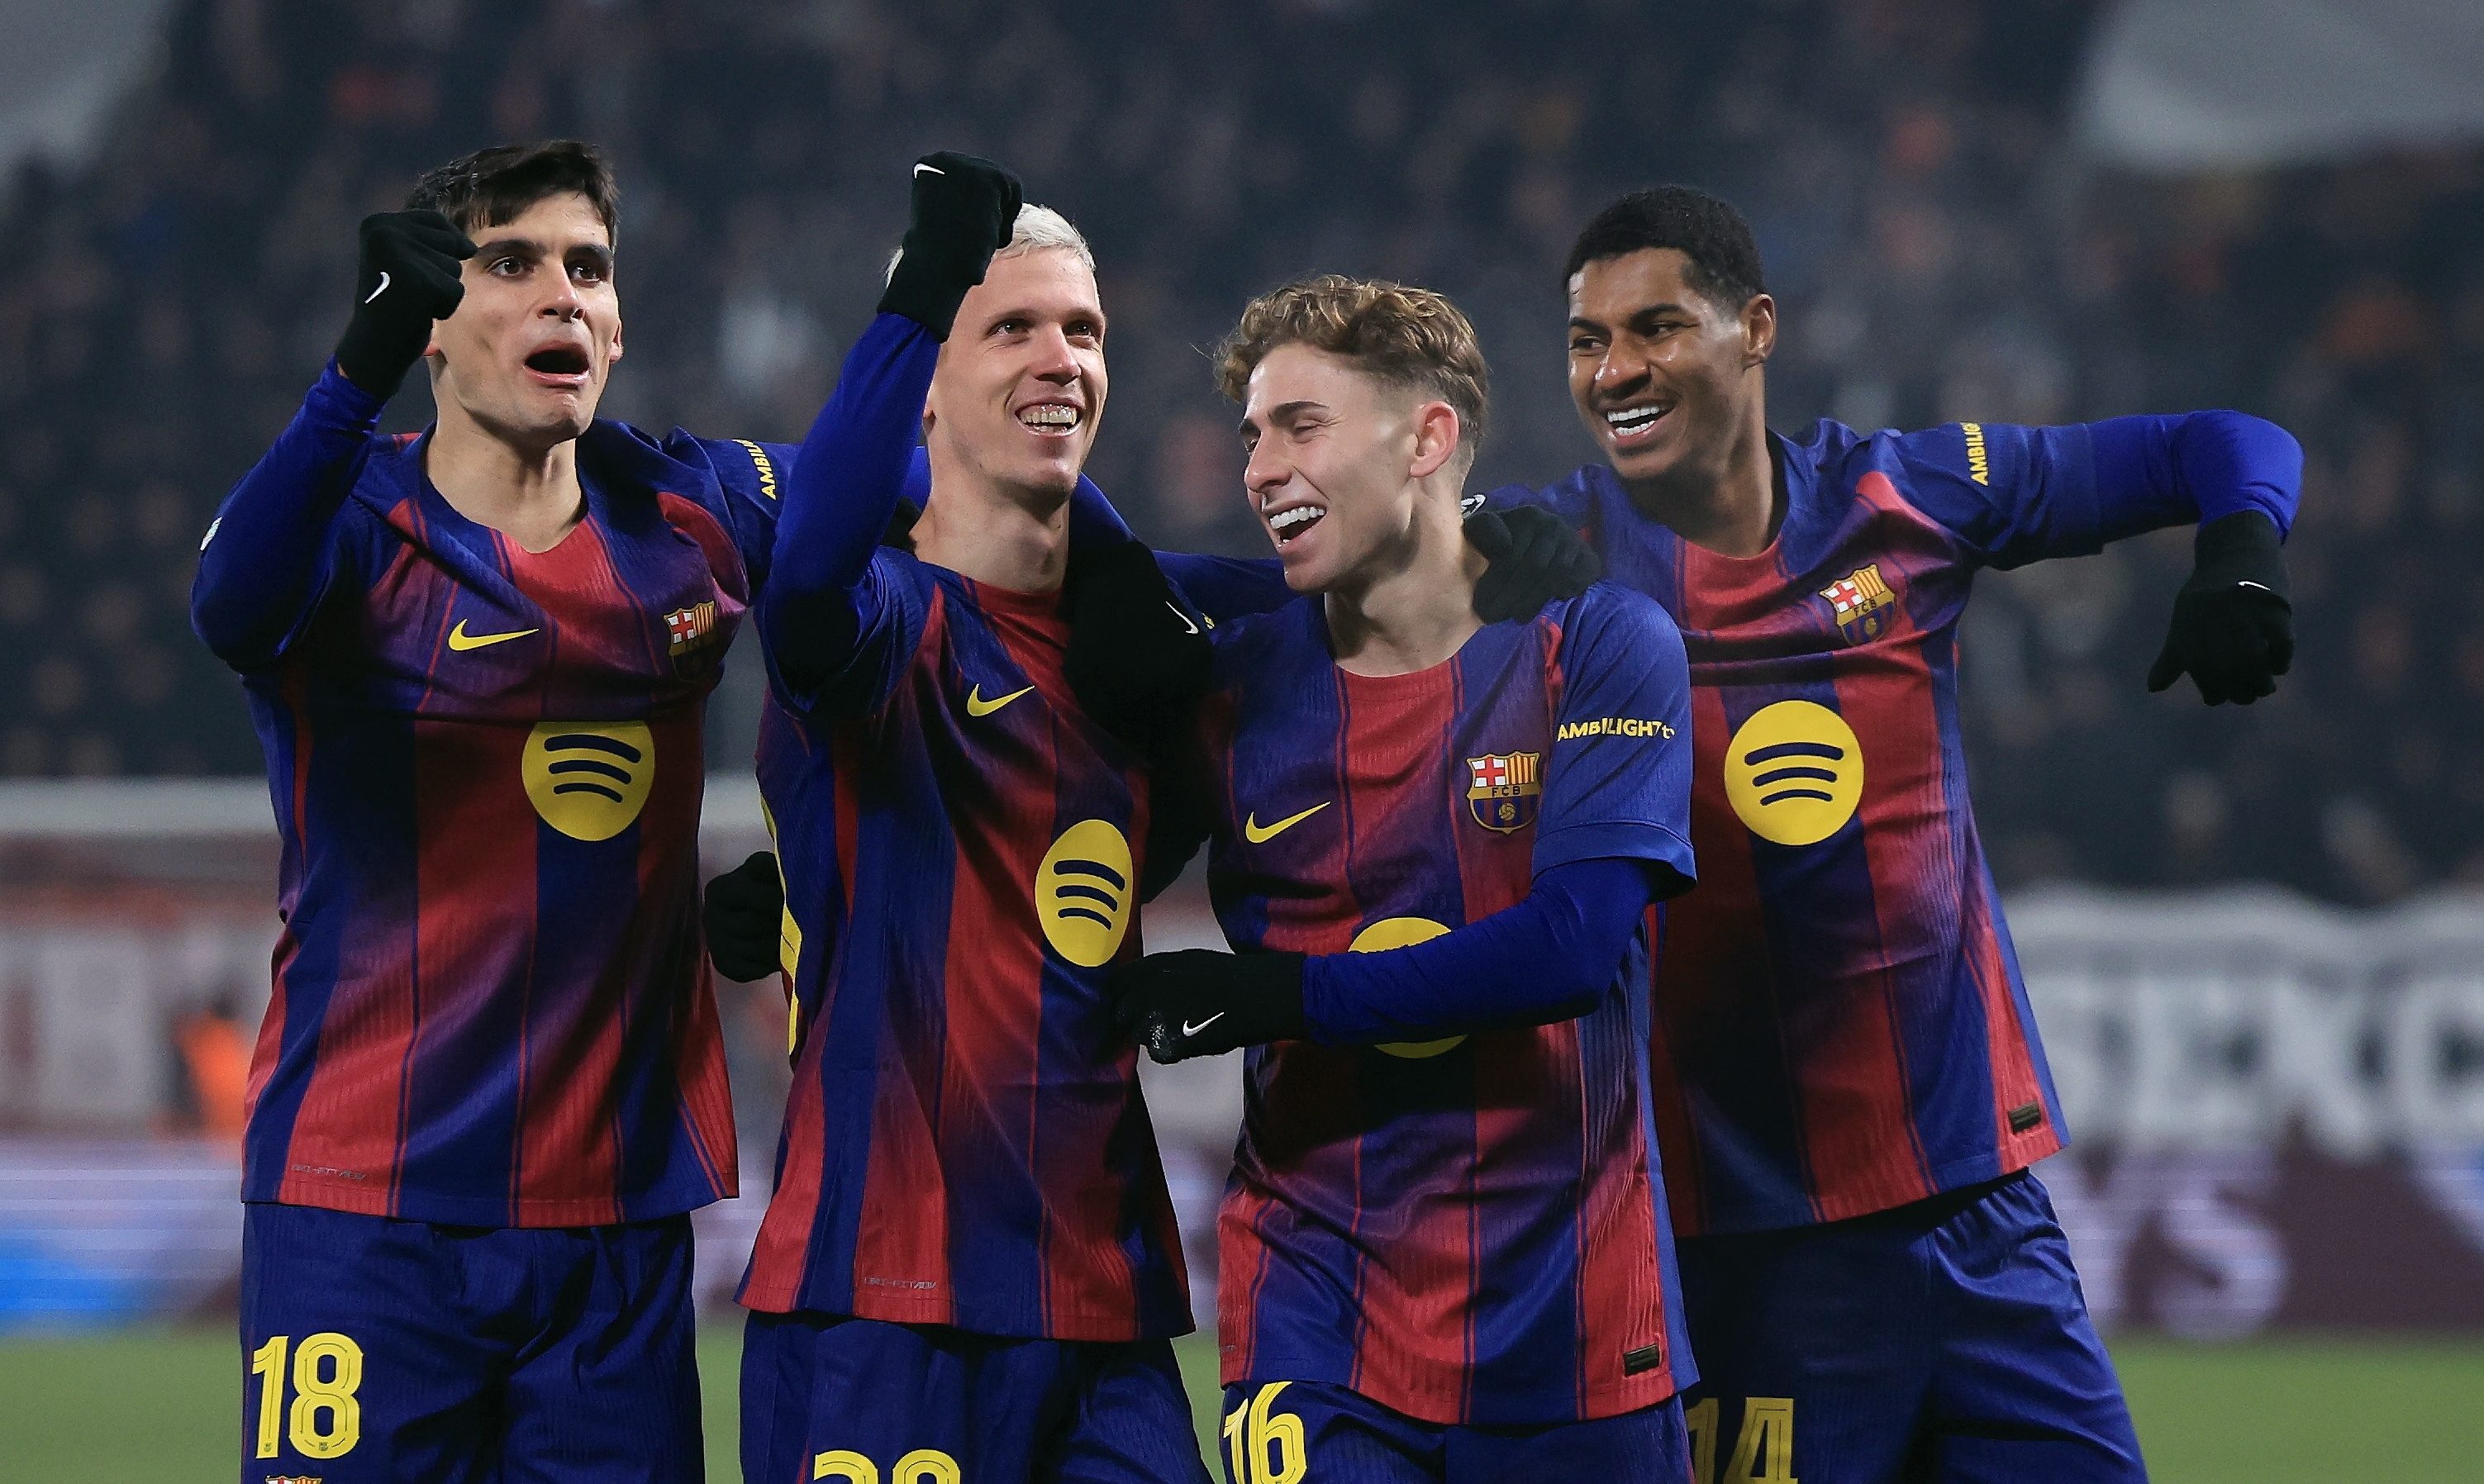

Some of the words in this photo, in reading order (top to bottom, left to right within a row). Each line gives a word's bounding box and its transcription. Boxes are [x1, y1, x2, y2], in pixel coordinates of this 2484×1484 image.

[1492, 785, 1520, 797] FCB
[251, 1332, 364, 1459] 18
[1223, 1381, 1307, 1484] 16
[1685, 1396, 1799, 1484] 14
